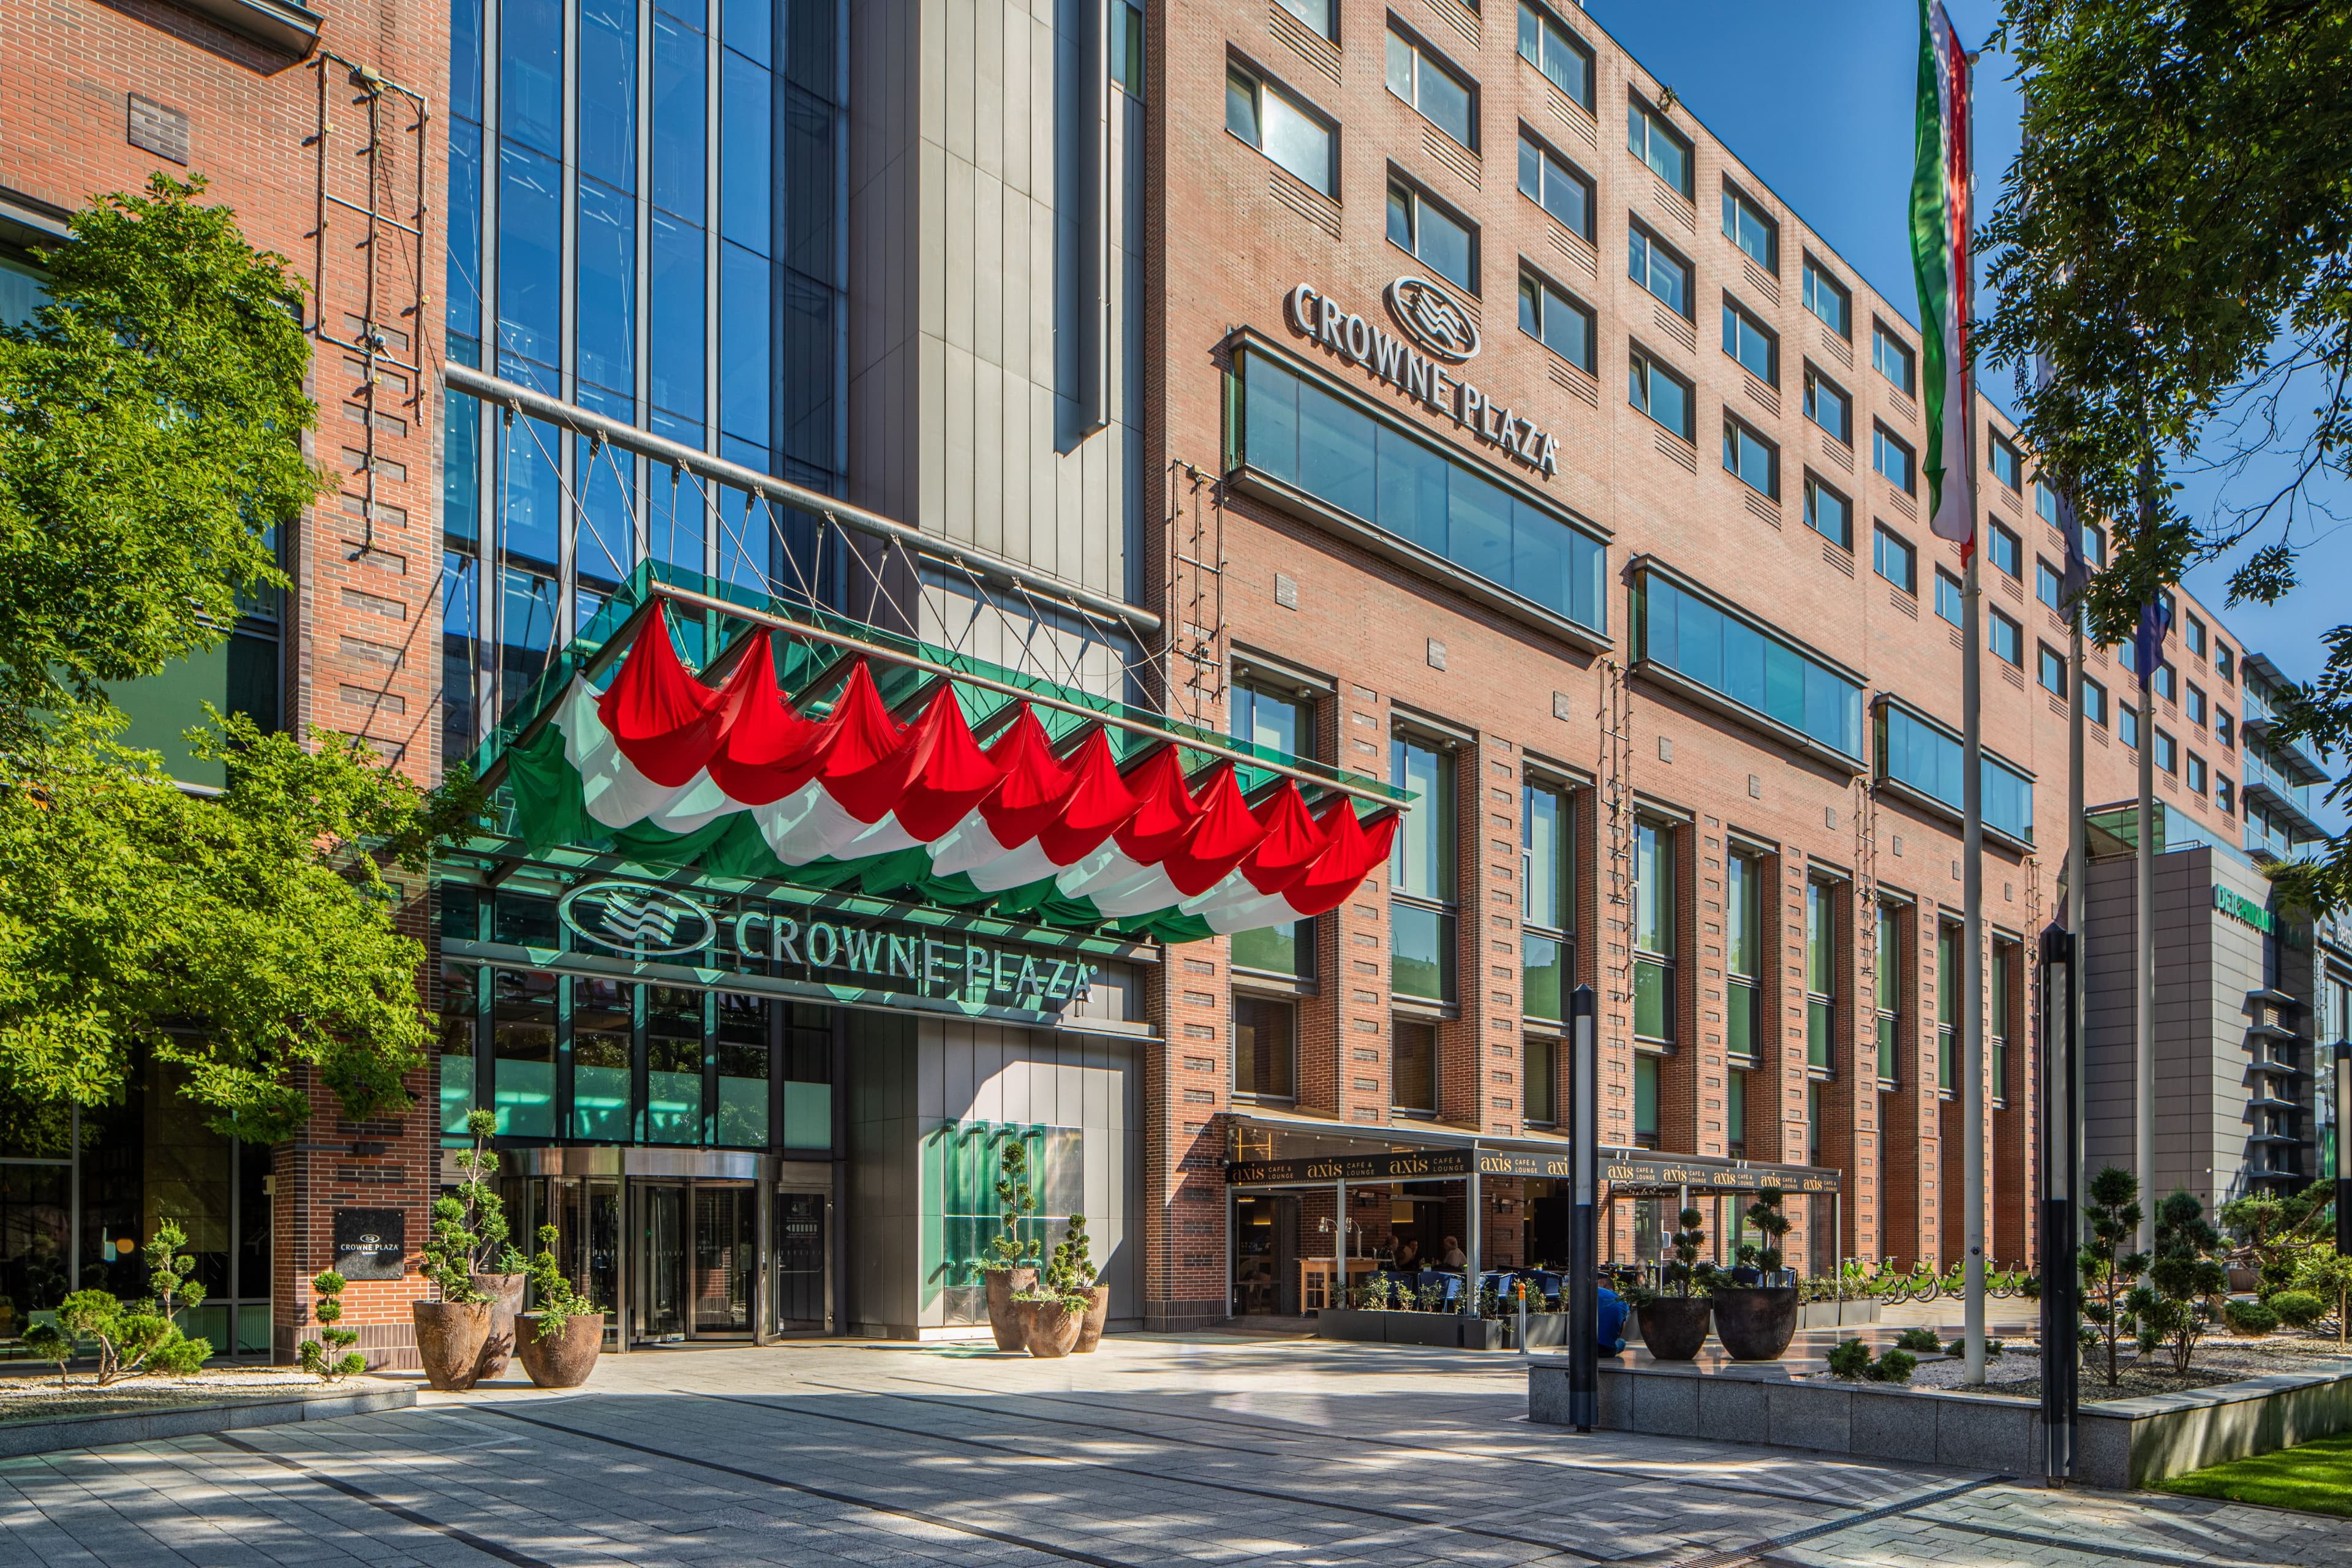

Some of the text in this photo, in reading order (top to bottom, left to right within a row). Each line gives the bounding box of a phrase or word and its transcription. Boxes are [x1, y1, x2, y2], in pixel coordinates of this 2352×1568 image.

[1294, 282, 1558, 475] CROWNE PLAZA
[736, 911, 1095, 1003] CROWNE PLAZA
[1307, 1158, 1343, 1178] axis
[1390, 1154, 1428, 1174] axis
[1480, 1152, 1512, 1172] axis
[1548, 1156, 1569, 1175] axi
[1608, 1161, 1634, 1179] axis
[1232, 1163, 1264, 1181] axis
[1663, 1164, 1687, 1182] axis
[1714, 1169, 1736, 1186] axis
[1761, 1172, 1781, 1188] axis
[1803, 1175, 1822, 1191] axis
